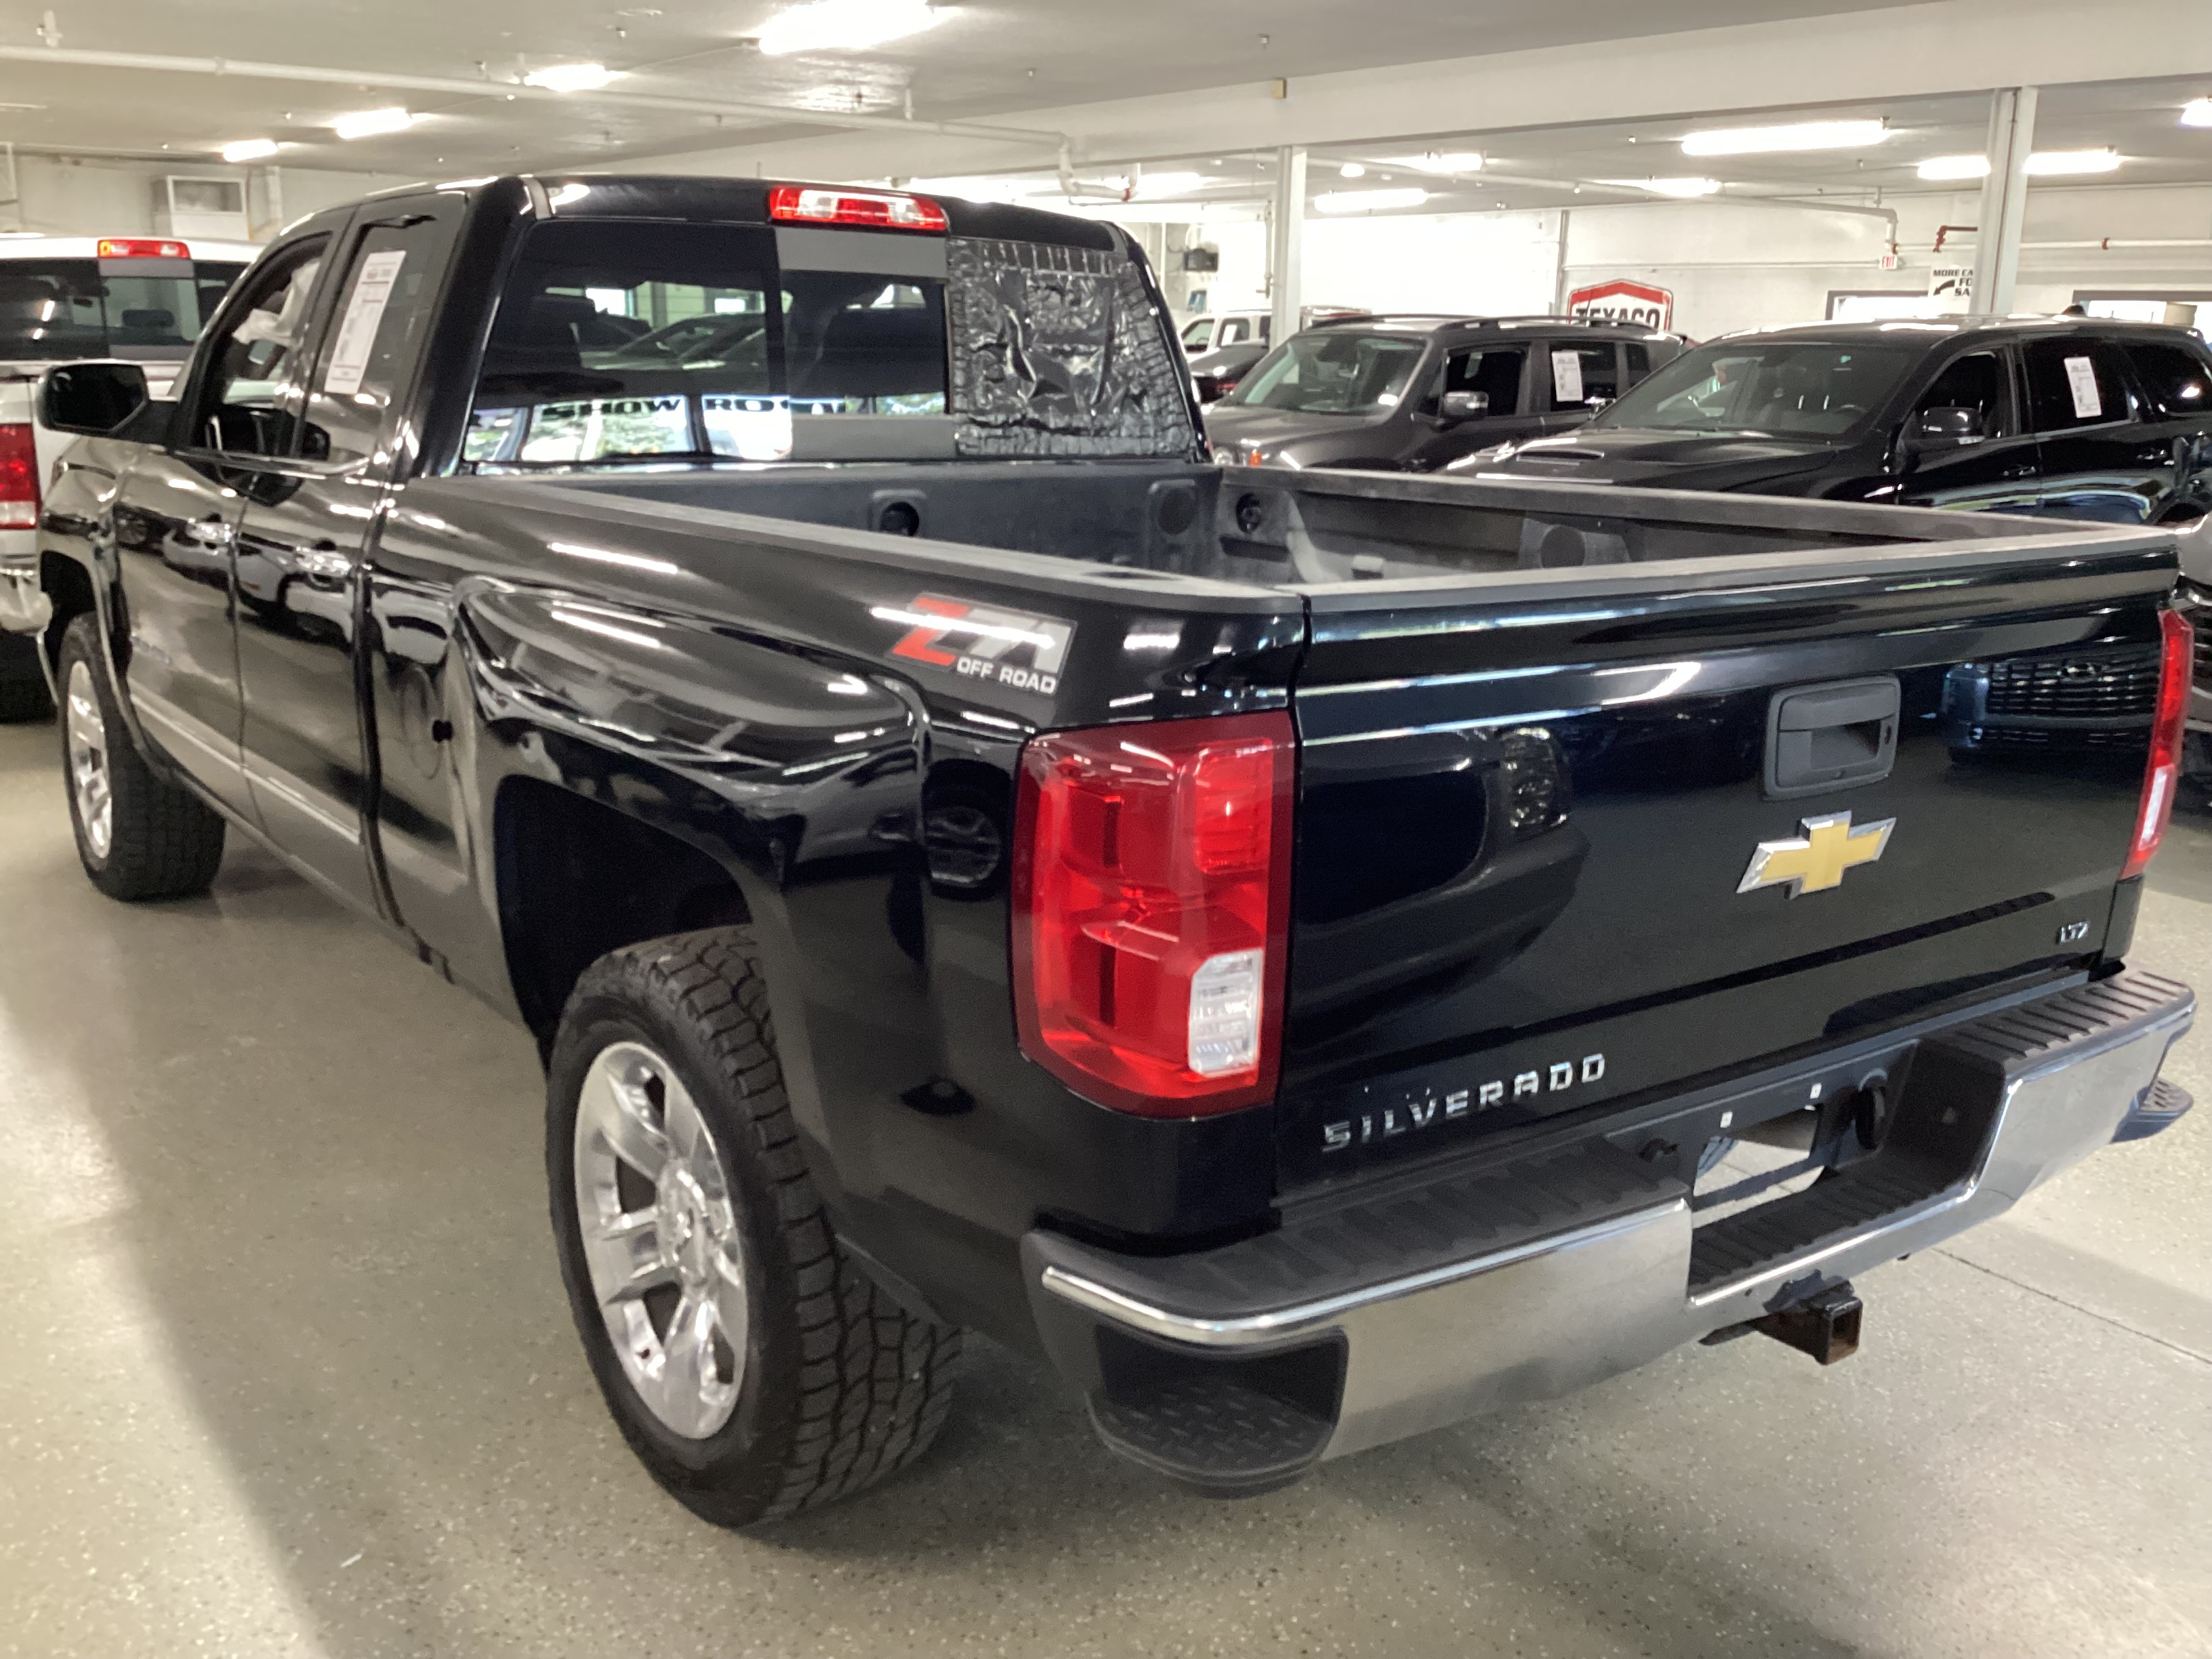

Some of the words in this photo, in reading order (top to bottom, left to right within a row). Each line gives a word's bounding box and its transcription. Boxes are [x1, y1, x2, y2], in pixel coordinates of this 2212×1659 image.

[1882, 255, 1895, 268] EXIT
[1954, 287, 1970, 296] SA
[1959, 278, 1972, 286] FO
[543, 398, 680, 422] SHOW
[892, 597, 1071, 673] Z71
[956, 657, 994, 678] OFF
[999, 666, 1057, 694] ROAD
[1322, 1053, 1605, 1153] SILVERADO
